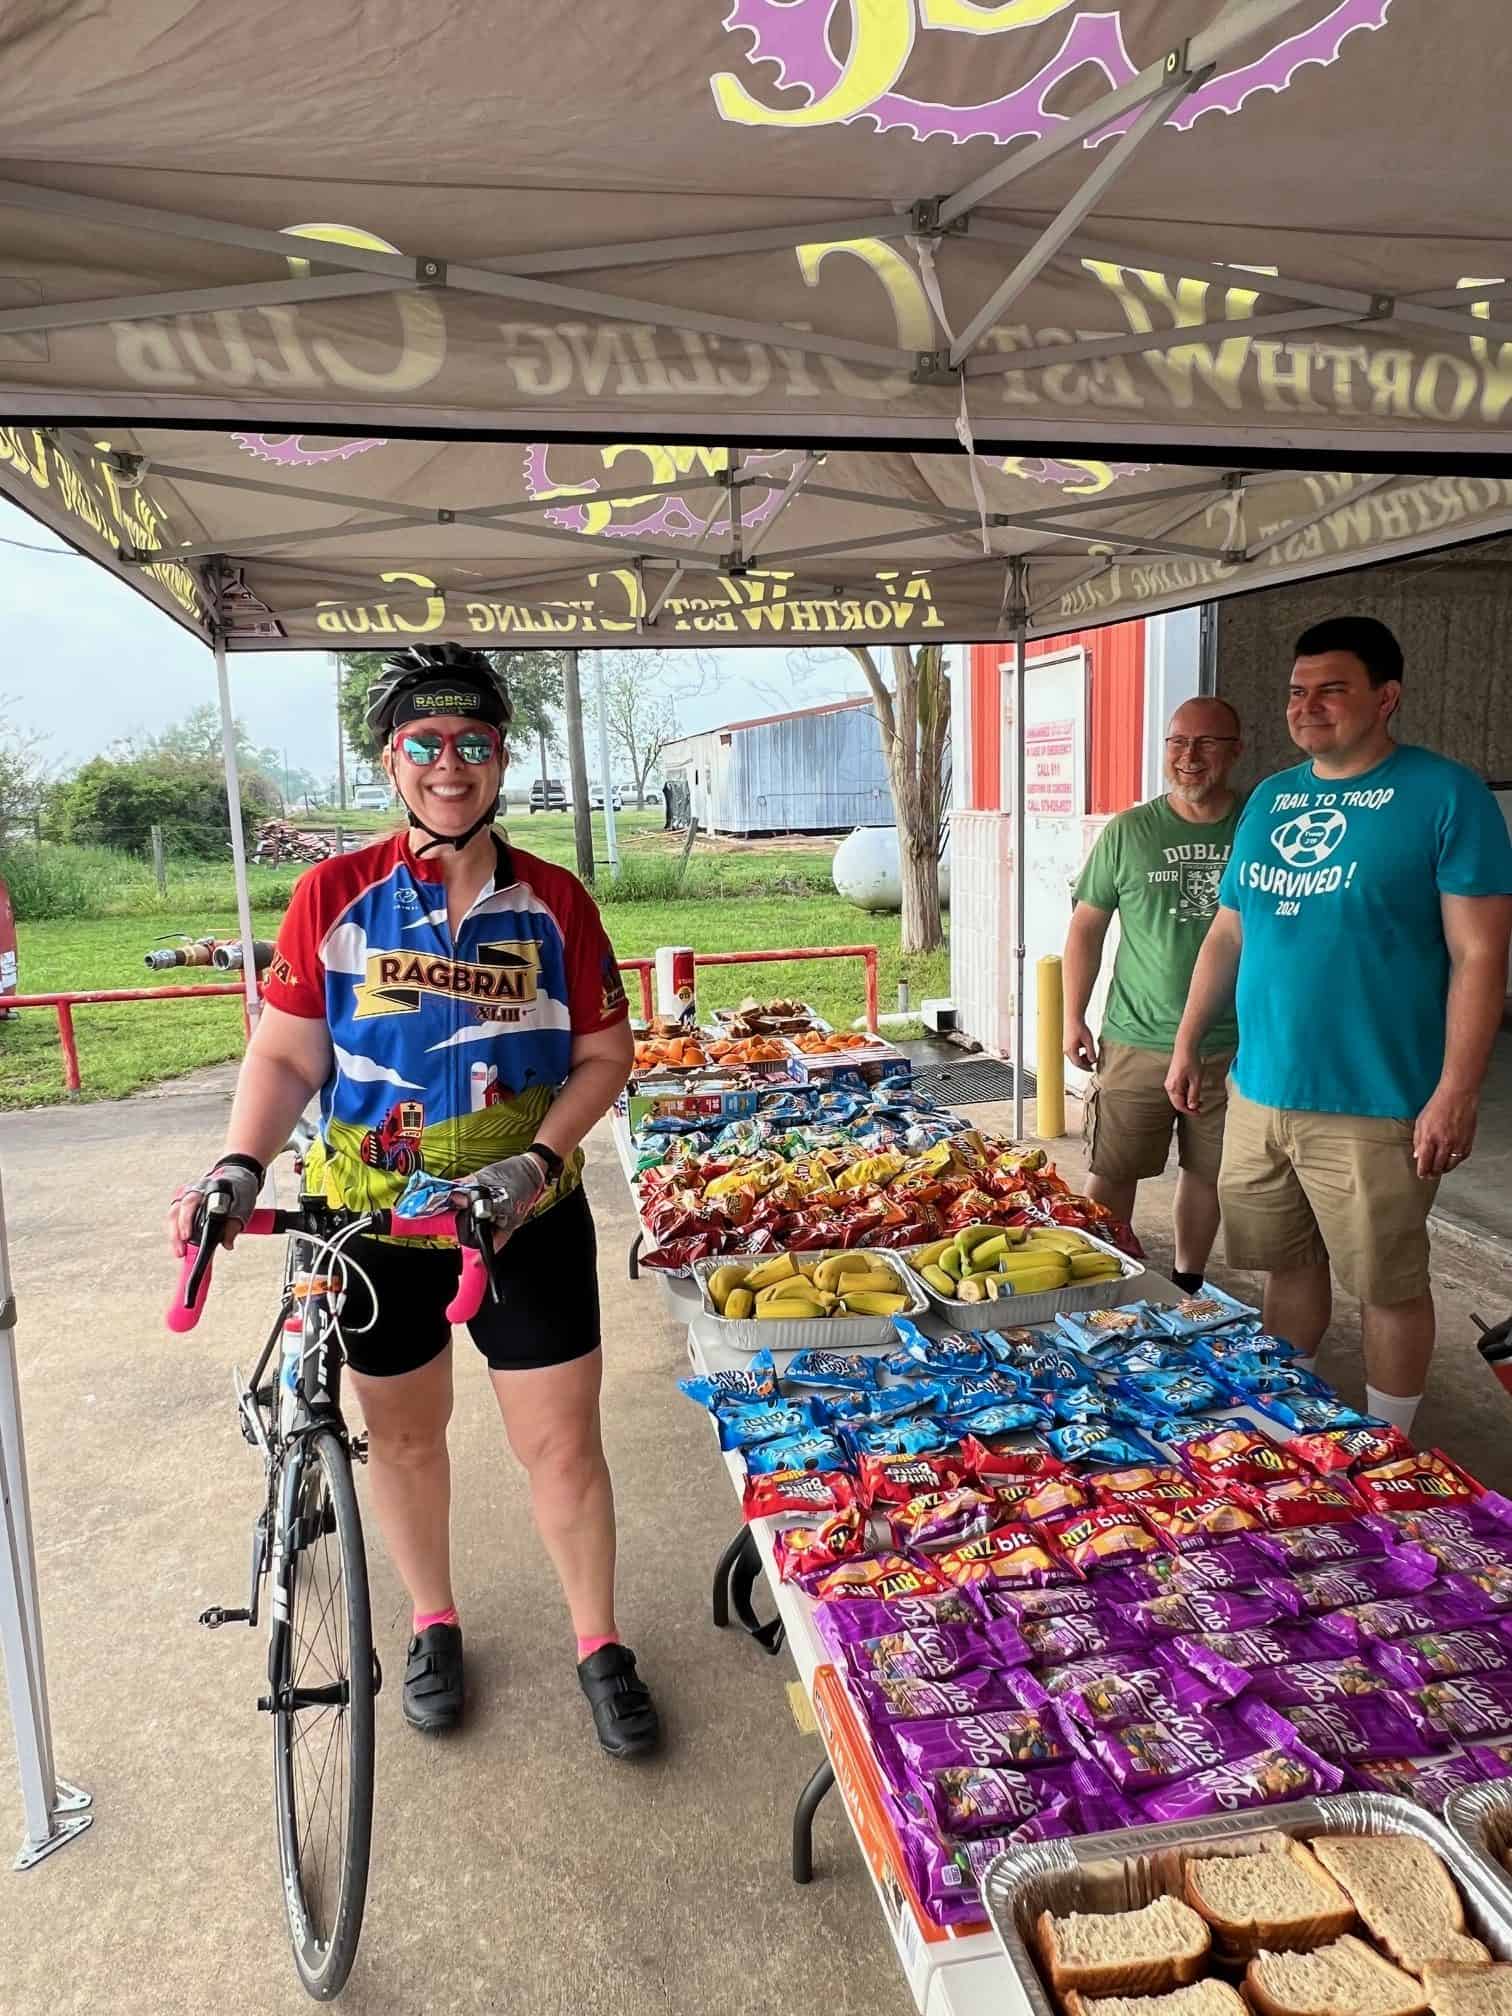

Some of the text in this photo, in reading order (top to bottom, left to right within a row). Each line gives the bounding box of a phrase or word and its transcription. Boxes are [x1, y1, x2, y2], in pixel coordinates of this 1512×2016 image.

[1270, 788, 1395, 814] TRAIL TO TROOP
[1162, 843, 1231, 864] DUBLI
[1240, 861, 1248, 886] I
[1249, 861, 1343, 898] SURVIVED
[1275, 901, 1300, 916] 2024
[379, 958, 525, 998] RAGBRAI
[475, 1006, 521, 1022] XLIII
[1059, 1519, 1097, 1547] RITZ
[956, 1538, 998, 1560] RITZ
